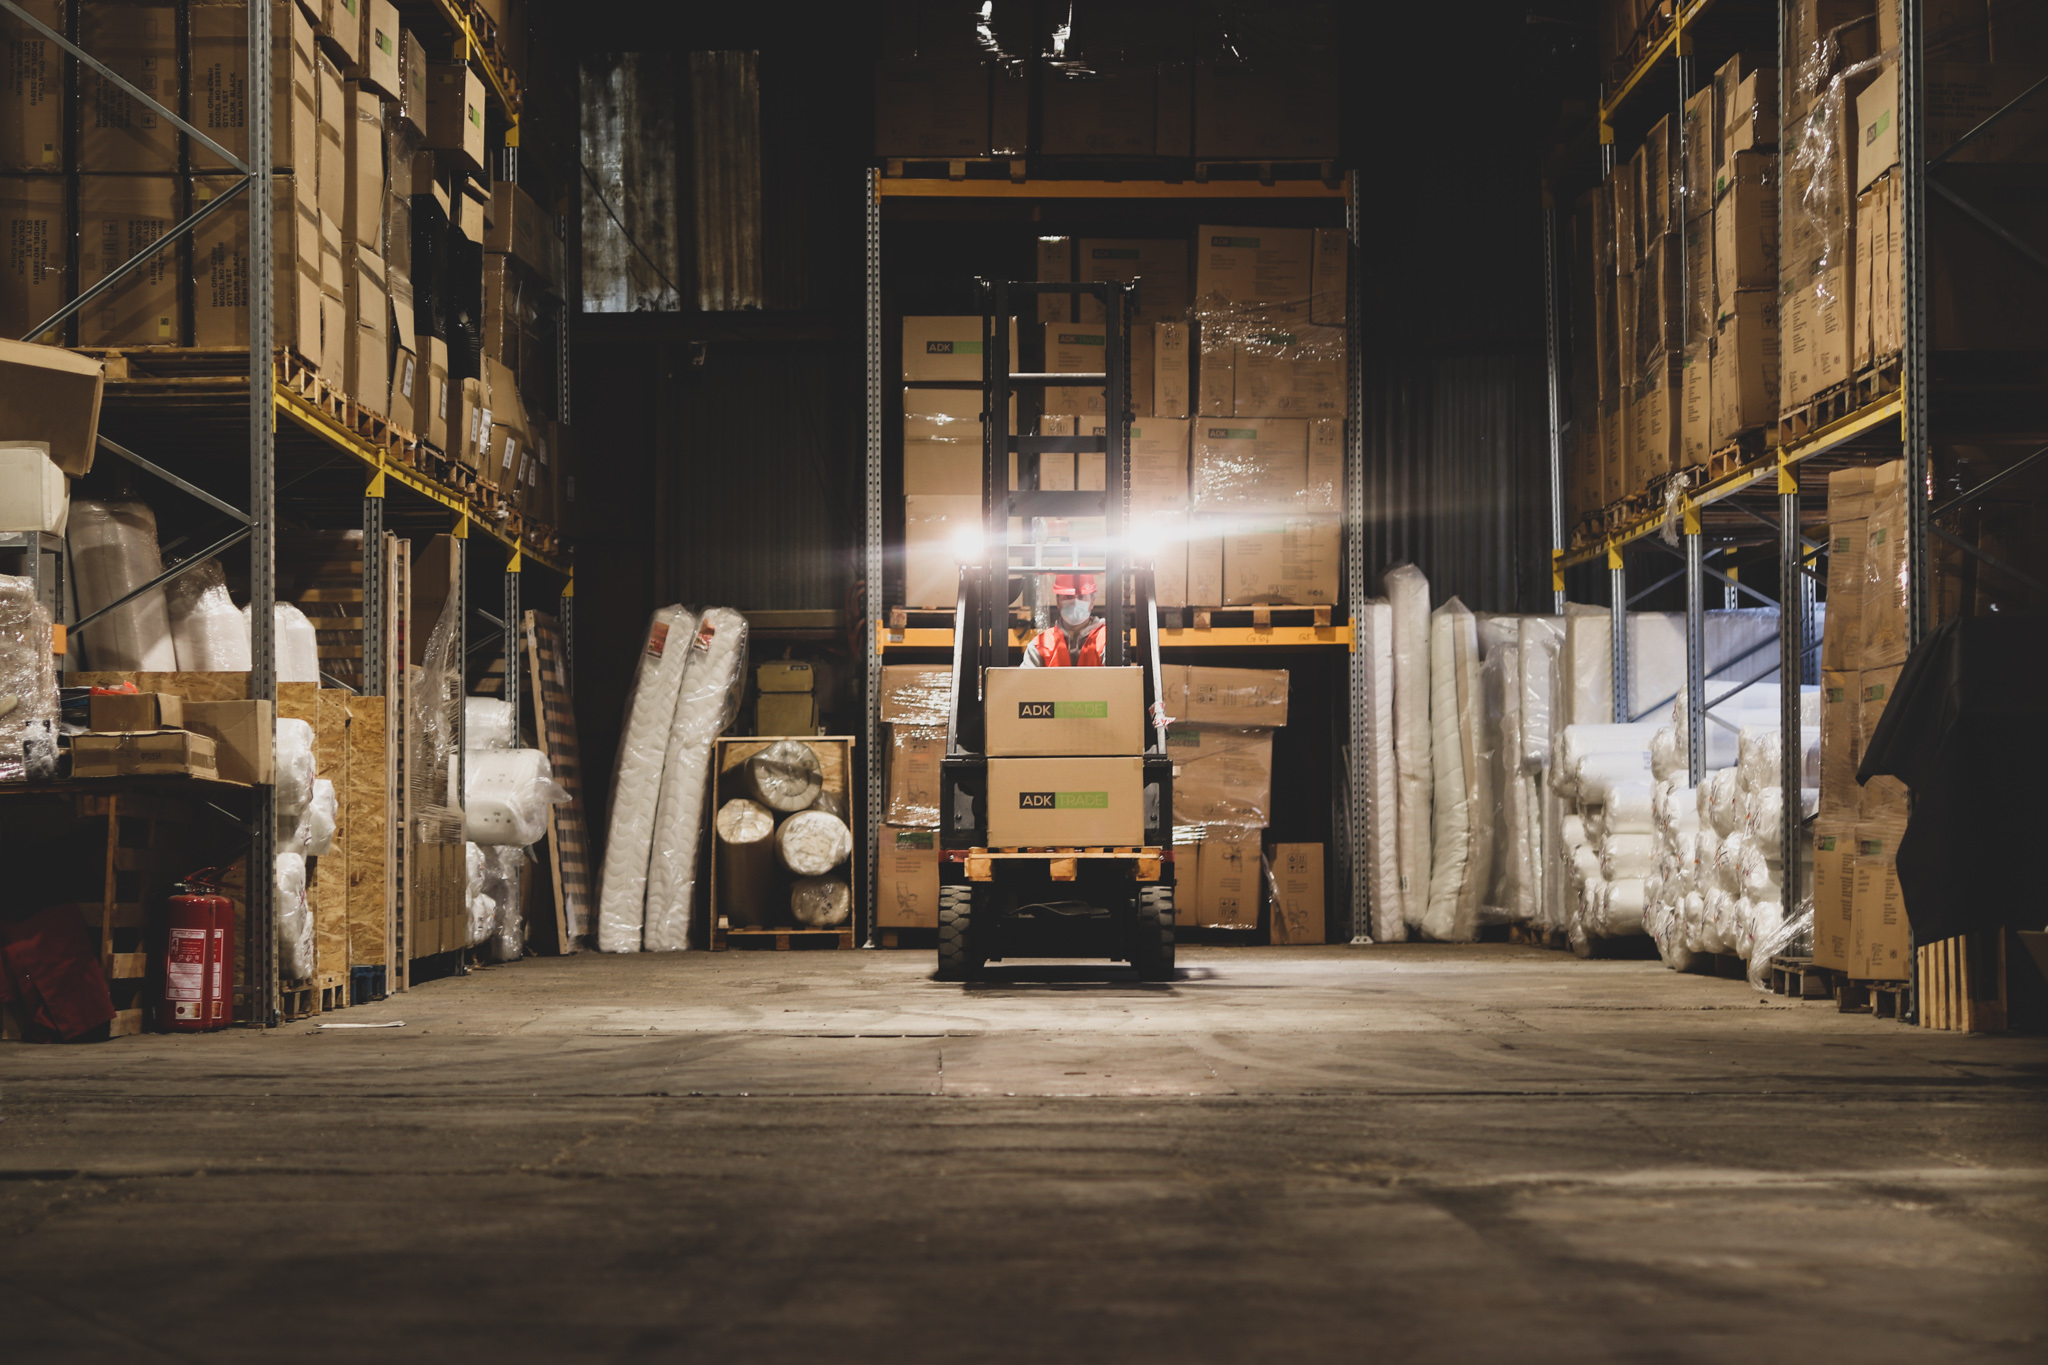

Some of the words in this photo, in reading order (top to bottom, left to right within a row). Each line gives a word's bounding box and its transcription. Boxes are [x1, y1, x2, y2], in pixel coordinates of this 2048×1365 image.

[1060, 335, 1077, 344] ADK
[929, 343, 951, 352] ADK
[1021, 704, 1051, 716] ADK
[1059, 704, 1103, 716] TRADE
[1022, 795, 1052, 806] ADK
[1058, 795, 1103, 806] TRADE
